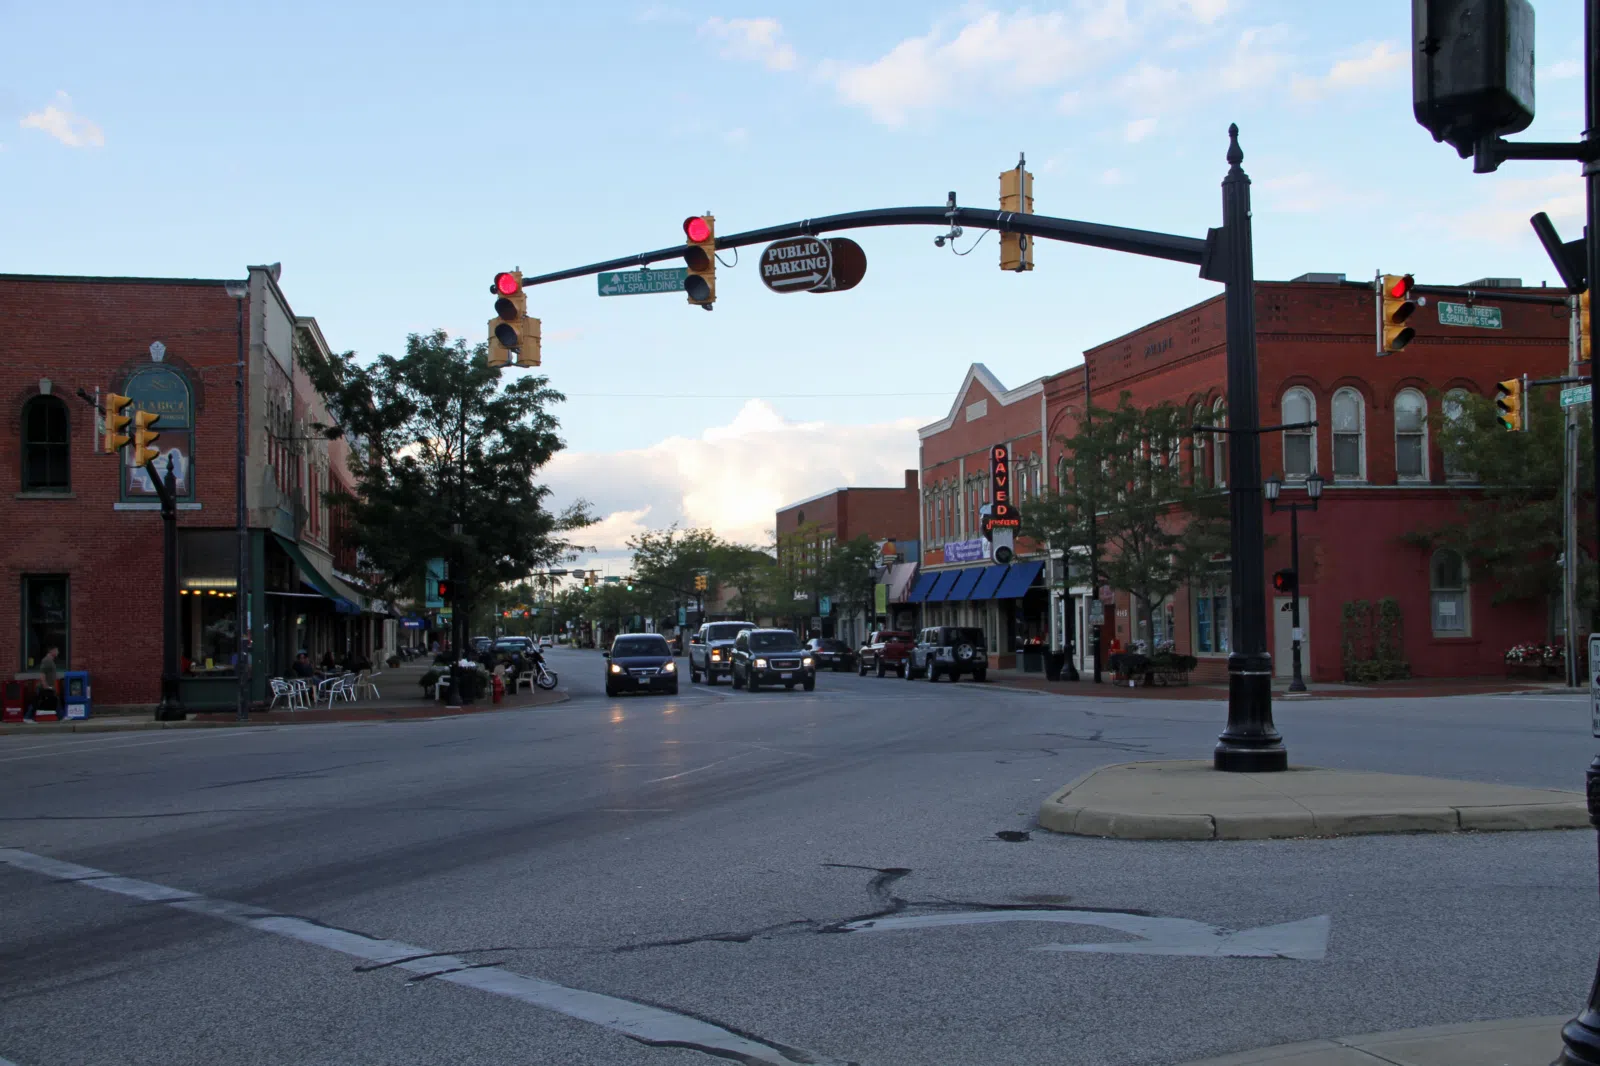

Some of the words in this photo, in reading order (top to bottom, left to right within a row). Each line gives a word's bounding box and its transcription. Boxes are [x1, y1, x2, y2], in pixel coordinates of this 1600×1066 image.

[768, 241, 820, 262] PUBLIC
[764, 256, 828, 277] PARKING
[623, 273, 644, 283] ERIE
[646, 270, 680, 281] STREET
[617, 284, 627, 293] W.
[628, 281, 677, 293] SPAULDING
[680, 280, 686, 289] S
[1453, 305, 1468, 315] ERIE
[1470, 307, 1493, 318] STREET
[1447, 313, 1479, 325] SPAULDING
